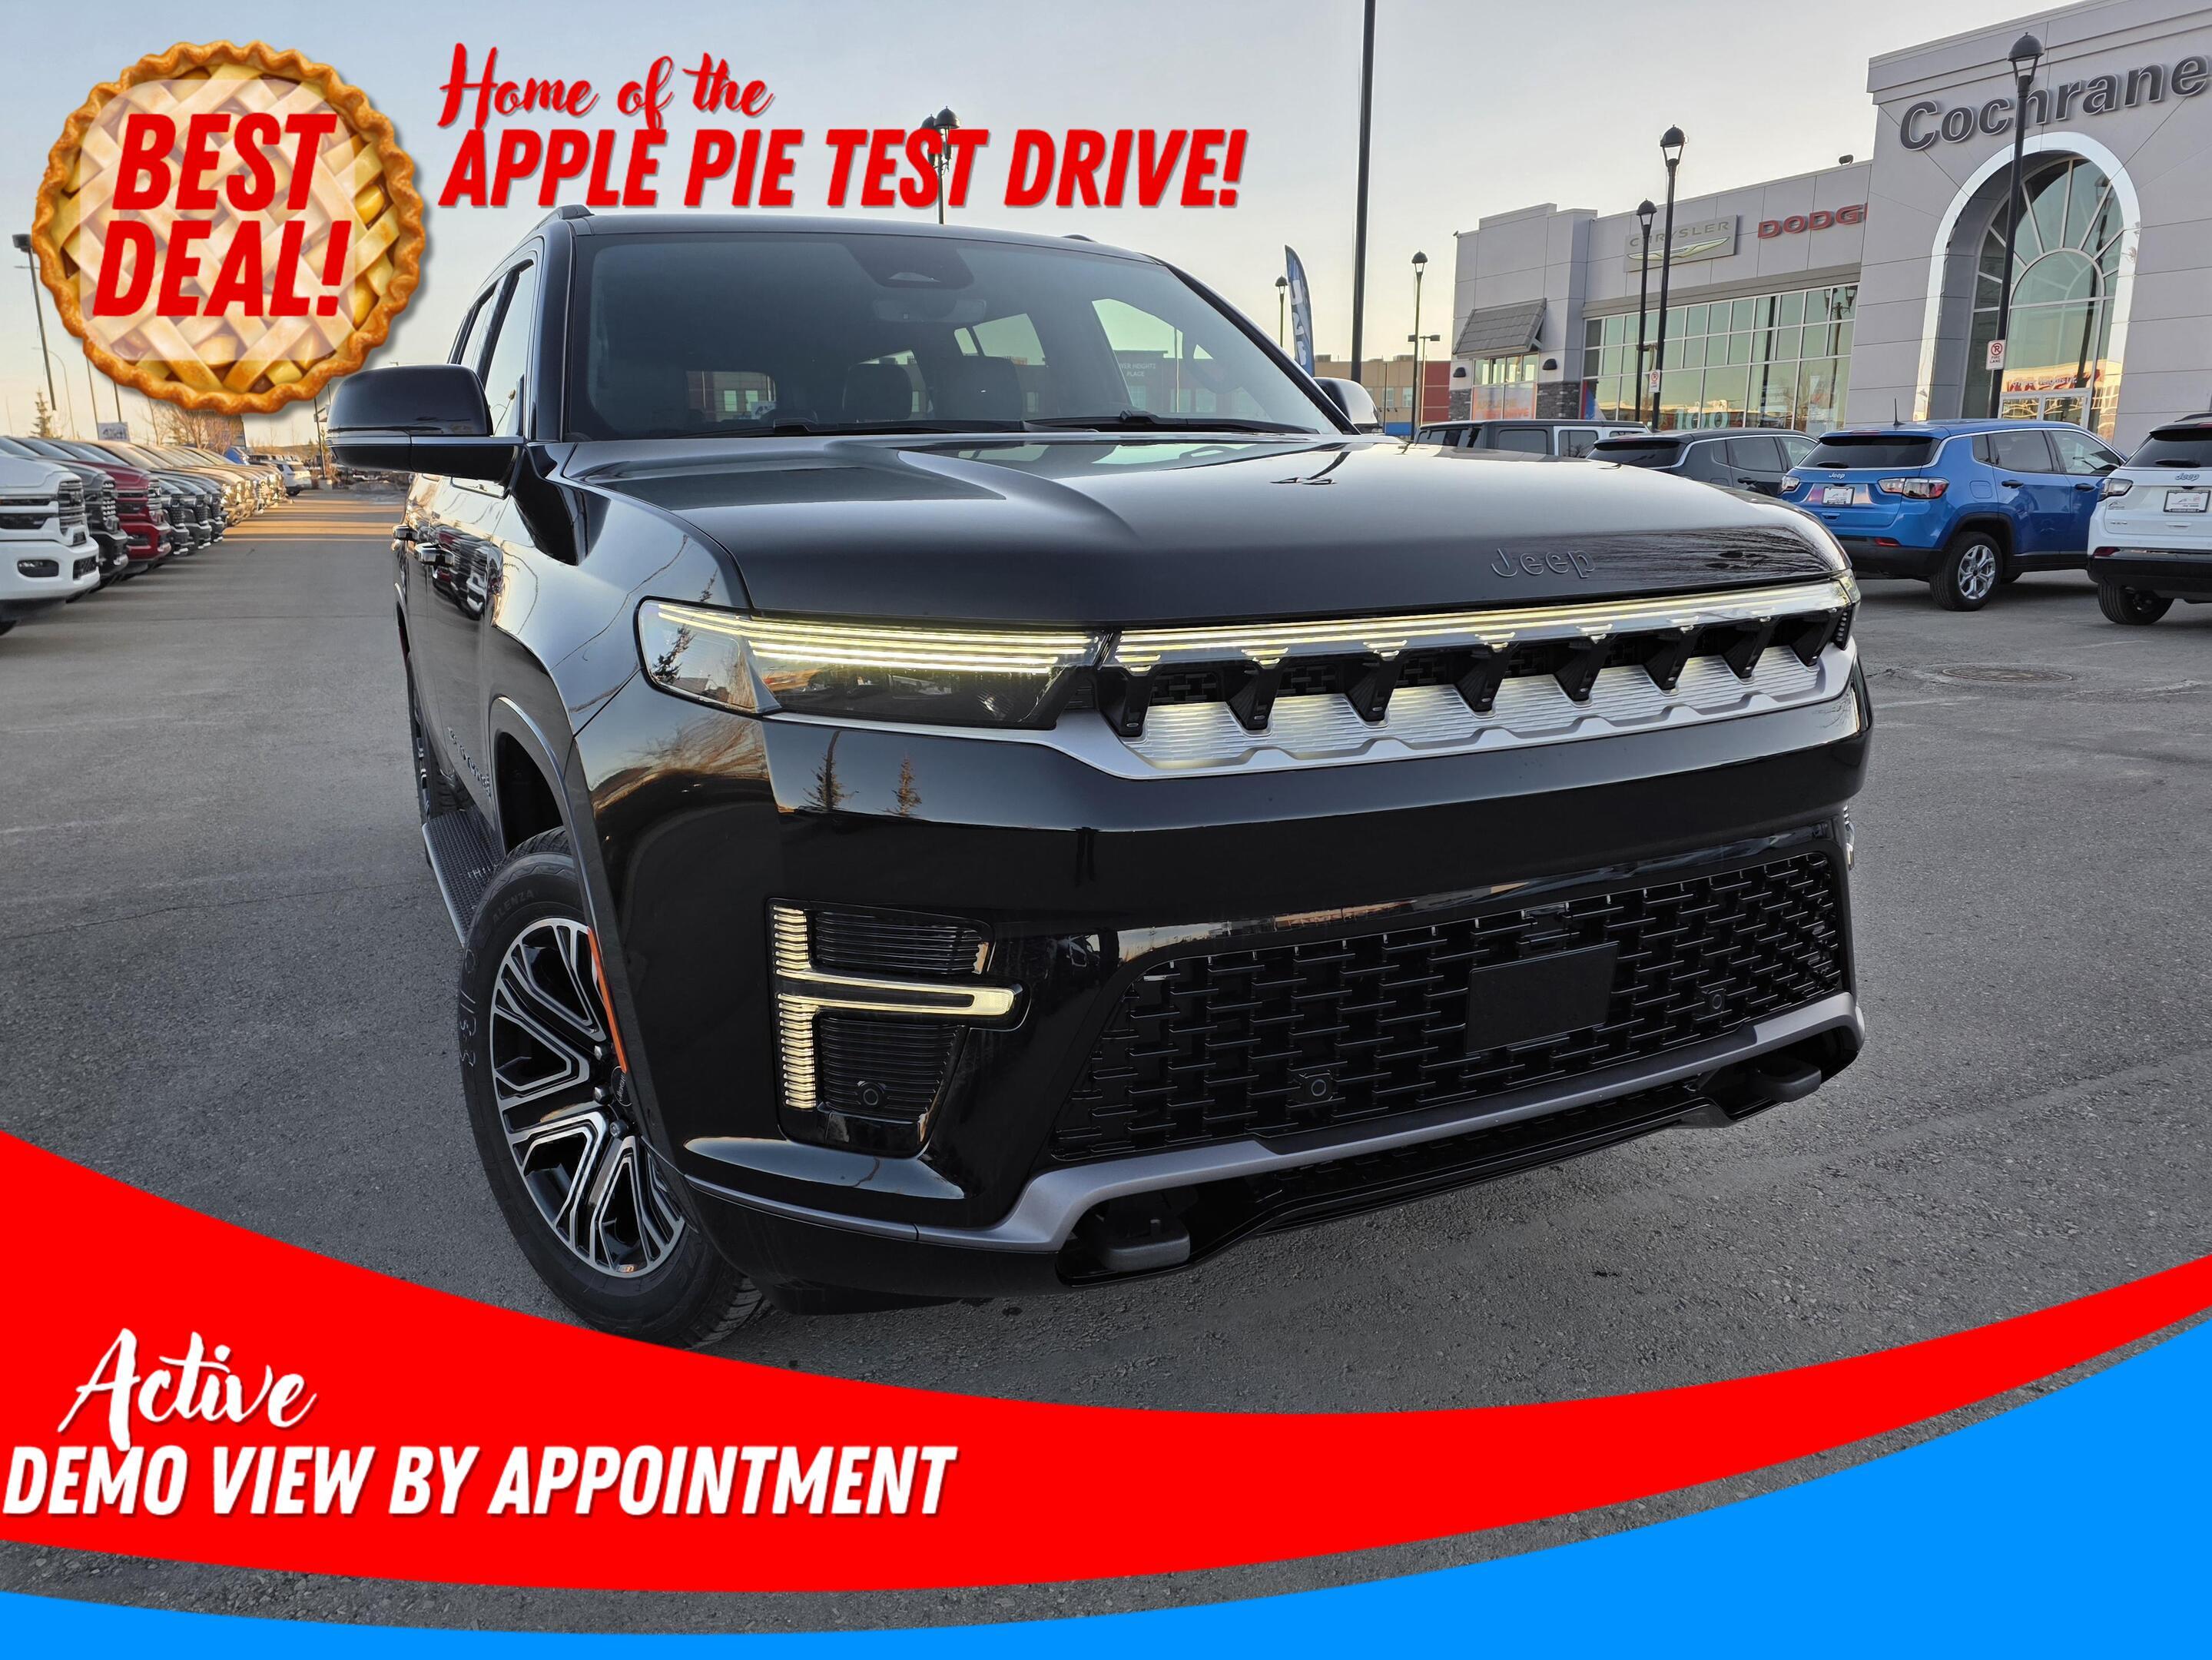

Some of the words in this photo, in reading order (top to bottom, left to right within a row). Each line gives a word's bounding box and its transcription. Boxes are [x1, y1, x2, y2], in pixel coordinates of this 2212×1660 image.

[1899, 55, 2210, 151] Cochrane
[1758, 203, 1869, 238] DODG
[2174, 473, 2200, 481] Jeep
[1491, 548, 1596, 578] Jeep
